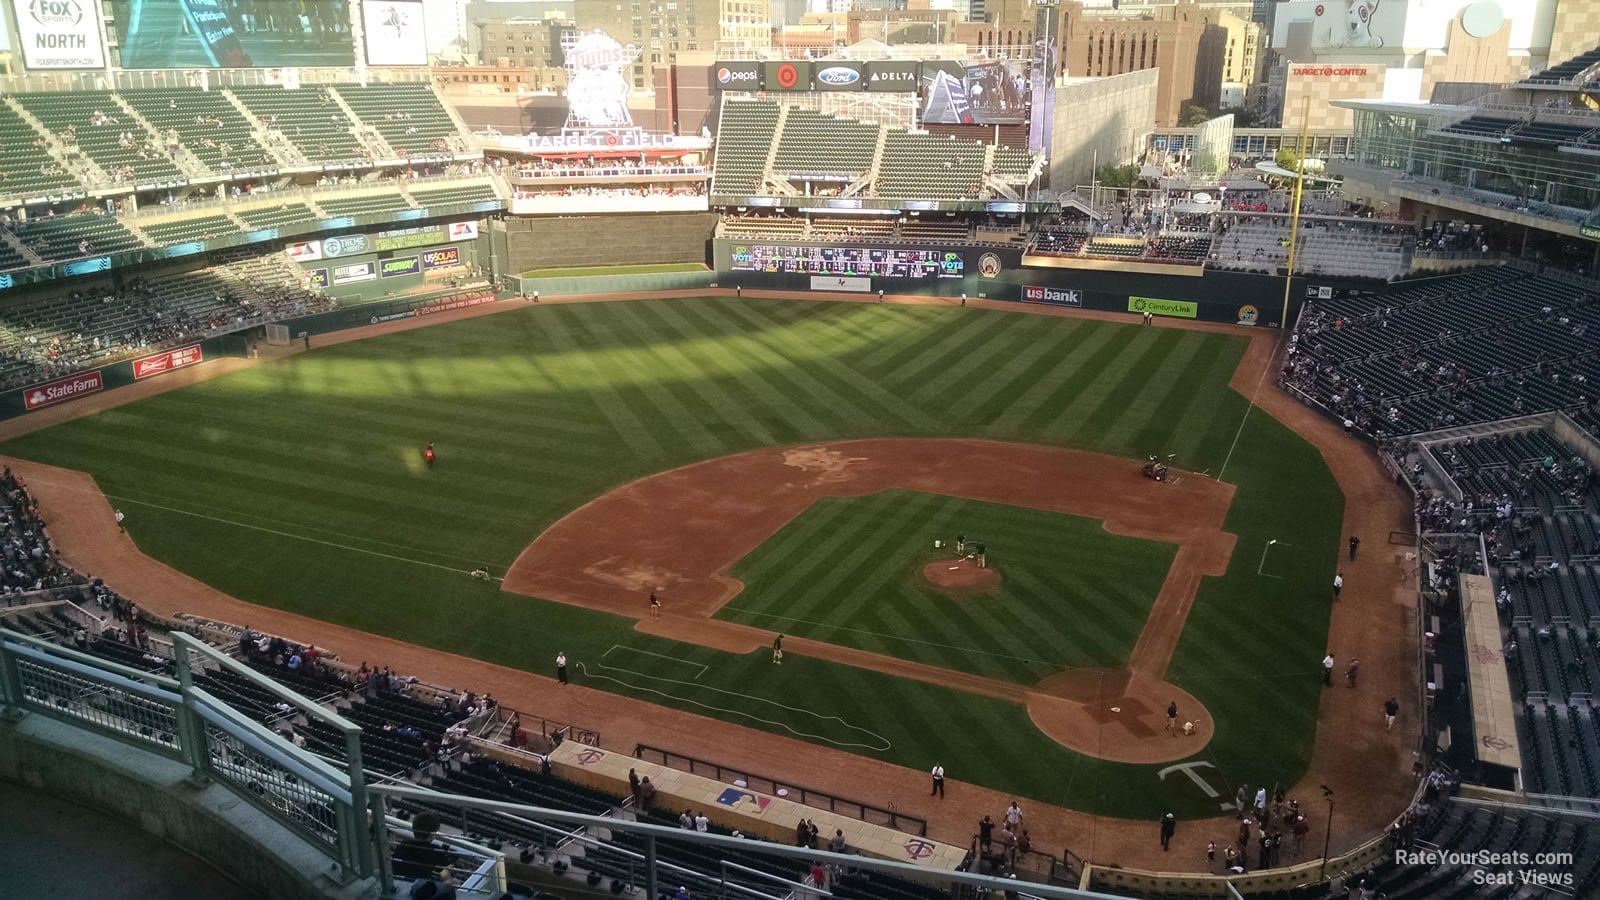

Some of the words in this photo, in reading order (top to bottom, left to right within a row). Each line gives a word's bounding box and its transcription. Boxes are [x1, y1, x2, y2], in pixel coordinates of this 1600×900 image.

[40, 0, 72, 16] FOX
[36, 33, 86, 48] NORTH
[569, 48, 621, 70] Twins
[731, 70, 757, 82] pepsi
[826, 71, 851, 82] Ford
[1293, 68, 1323, 76] TARGET
[1333, 68, 1367, 76] CENTER
[529, 136, 603, 147] TARGET
[622, 135, 675, 146] FIELD
[340, 237, 365, 248] THEME
[732, 254, 753, 262] VOTE
[383, 259, 418, 272] SUBWAY
[940, 260, 964, 270] VOTE
[421, 306, 430, 314] 25
[1148, 303, 1192, 313] CenturyLink
